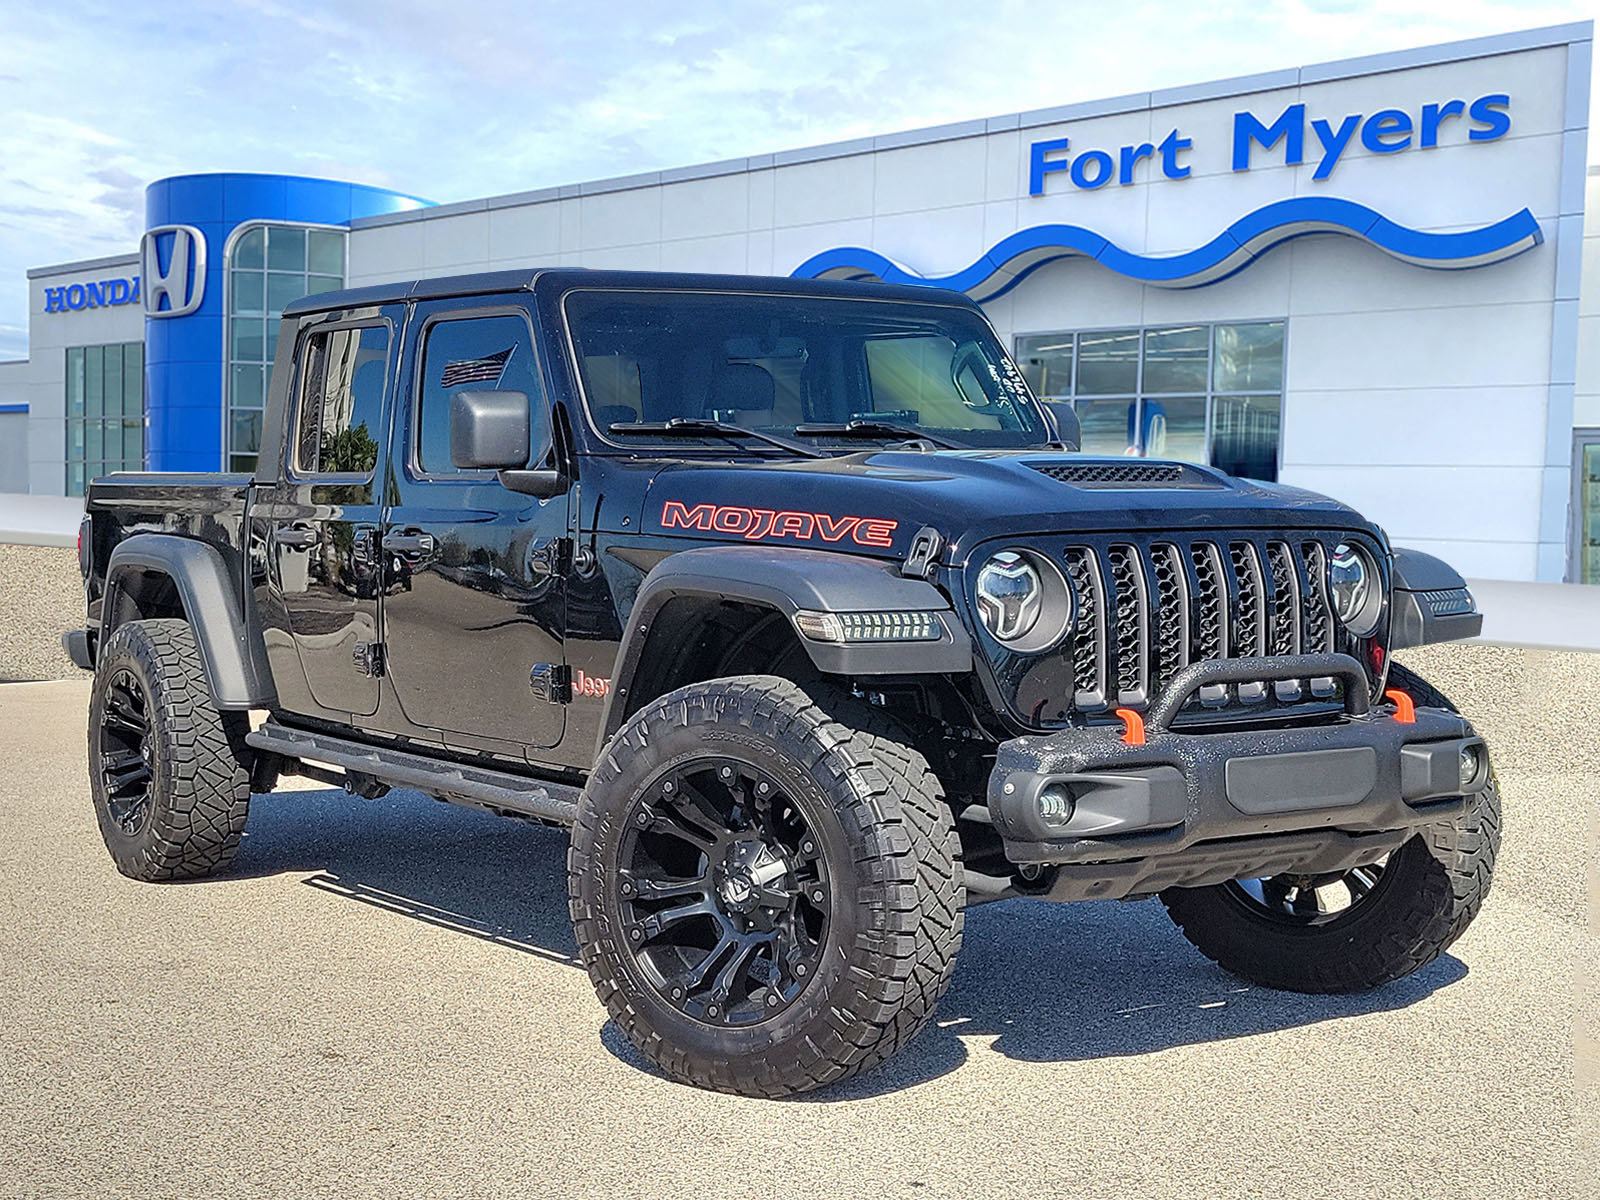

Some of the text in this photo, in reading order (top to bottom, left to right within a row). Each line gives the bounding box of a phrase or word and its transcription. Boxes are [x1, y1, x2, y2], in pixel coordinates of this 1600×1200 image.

[1029, 93, 1510, 197] Fort Myers
[661, 501, 898, 547] MOJAVE
